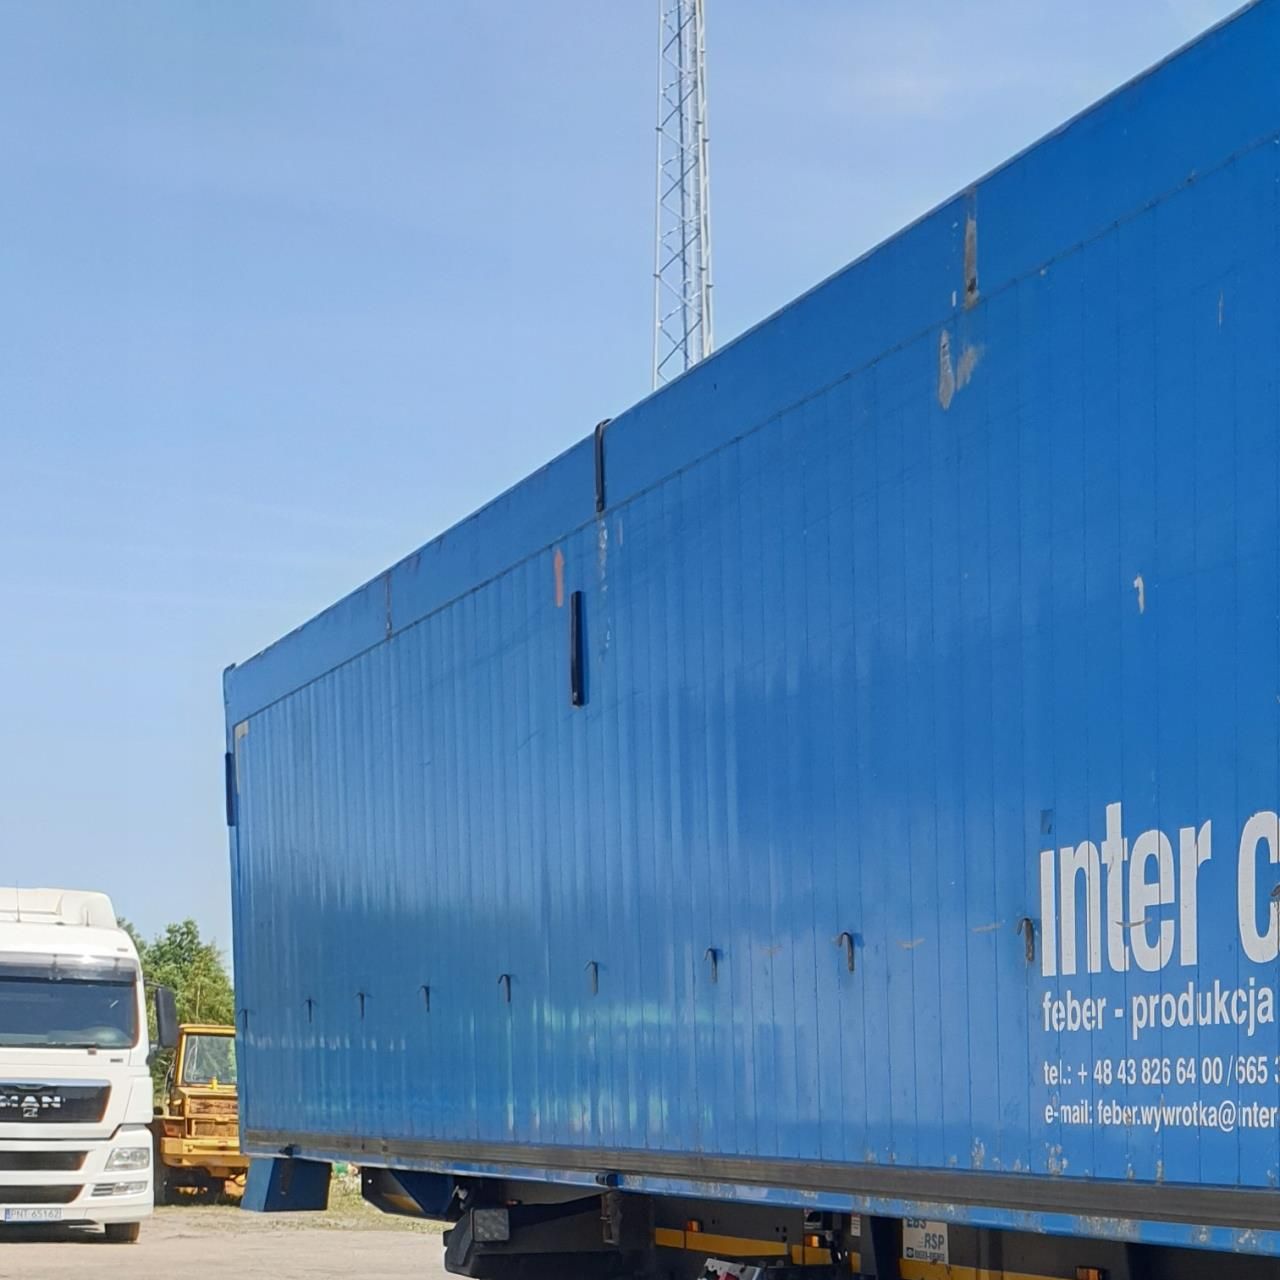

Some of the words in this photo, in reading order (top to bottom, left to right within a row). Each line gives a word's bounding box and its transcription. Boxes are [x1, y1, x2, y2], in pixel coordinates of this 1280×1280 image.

[1040, 801, 1212, 976] inter
[1043, 990, 1106, 1032] feber
[1132, 977, 1274, 1041] produkcja
[1093, 1059, 1113, 1085] 48
[1117, 1058, 1137, 1085] 43
[1141, 1057, 1171, 1085] 826
[1176, 1057, 1196, 1085] 64
[1202, 1056, 1223, 1085] 00
[924, 1232, 945, 1250] RSP
